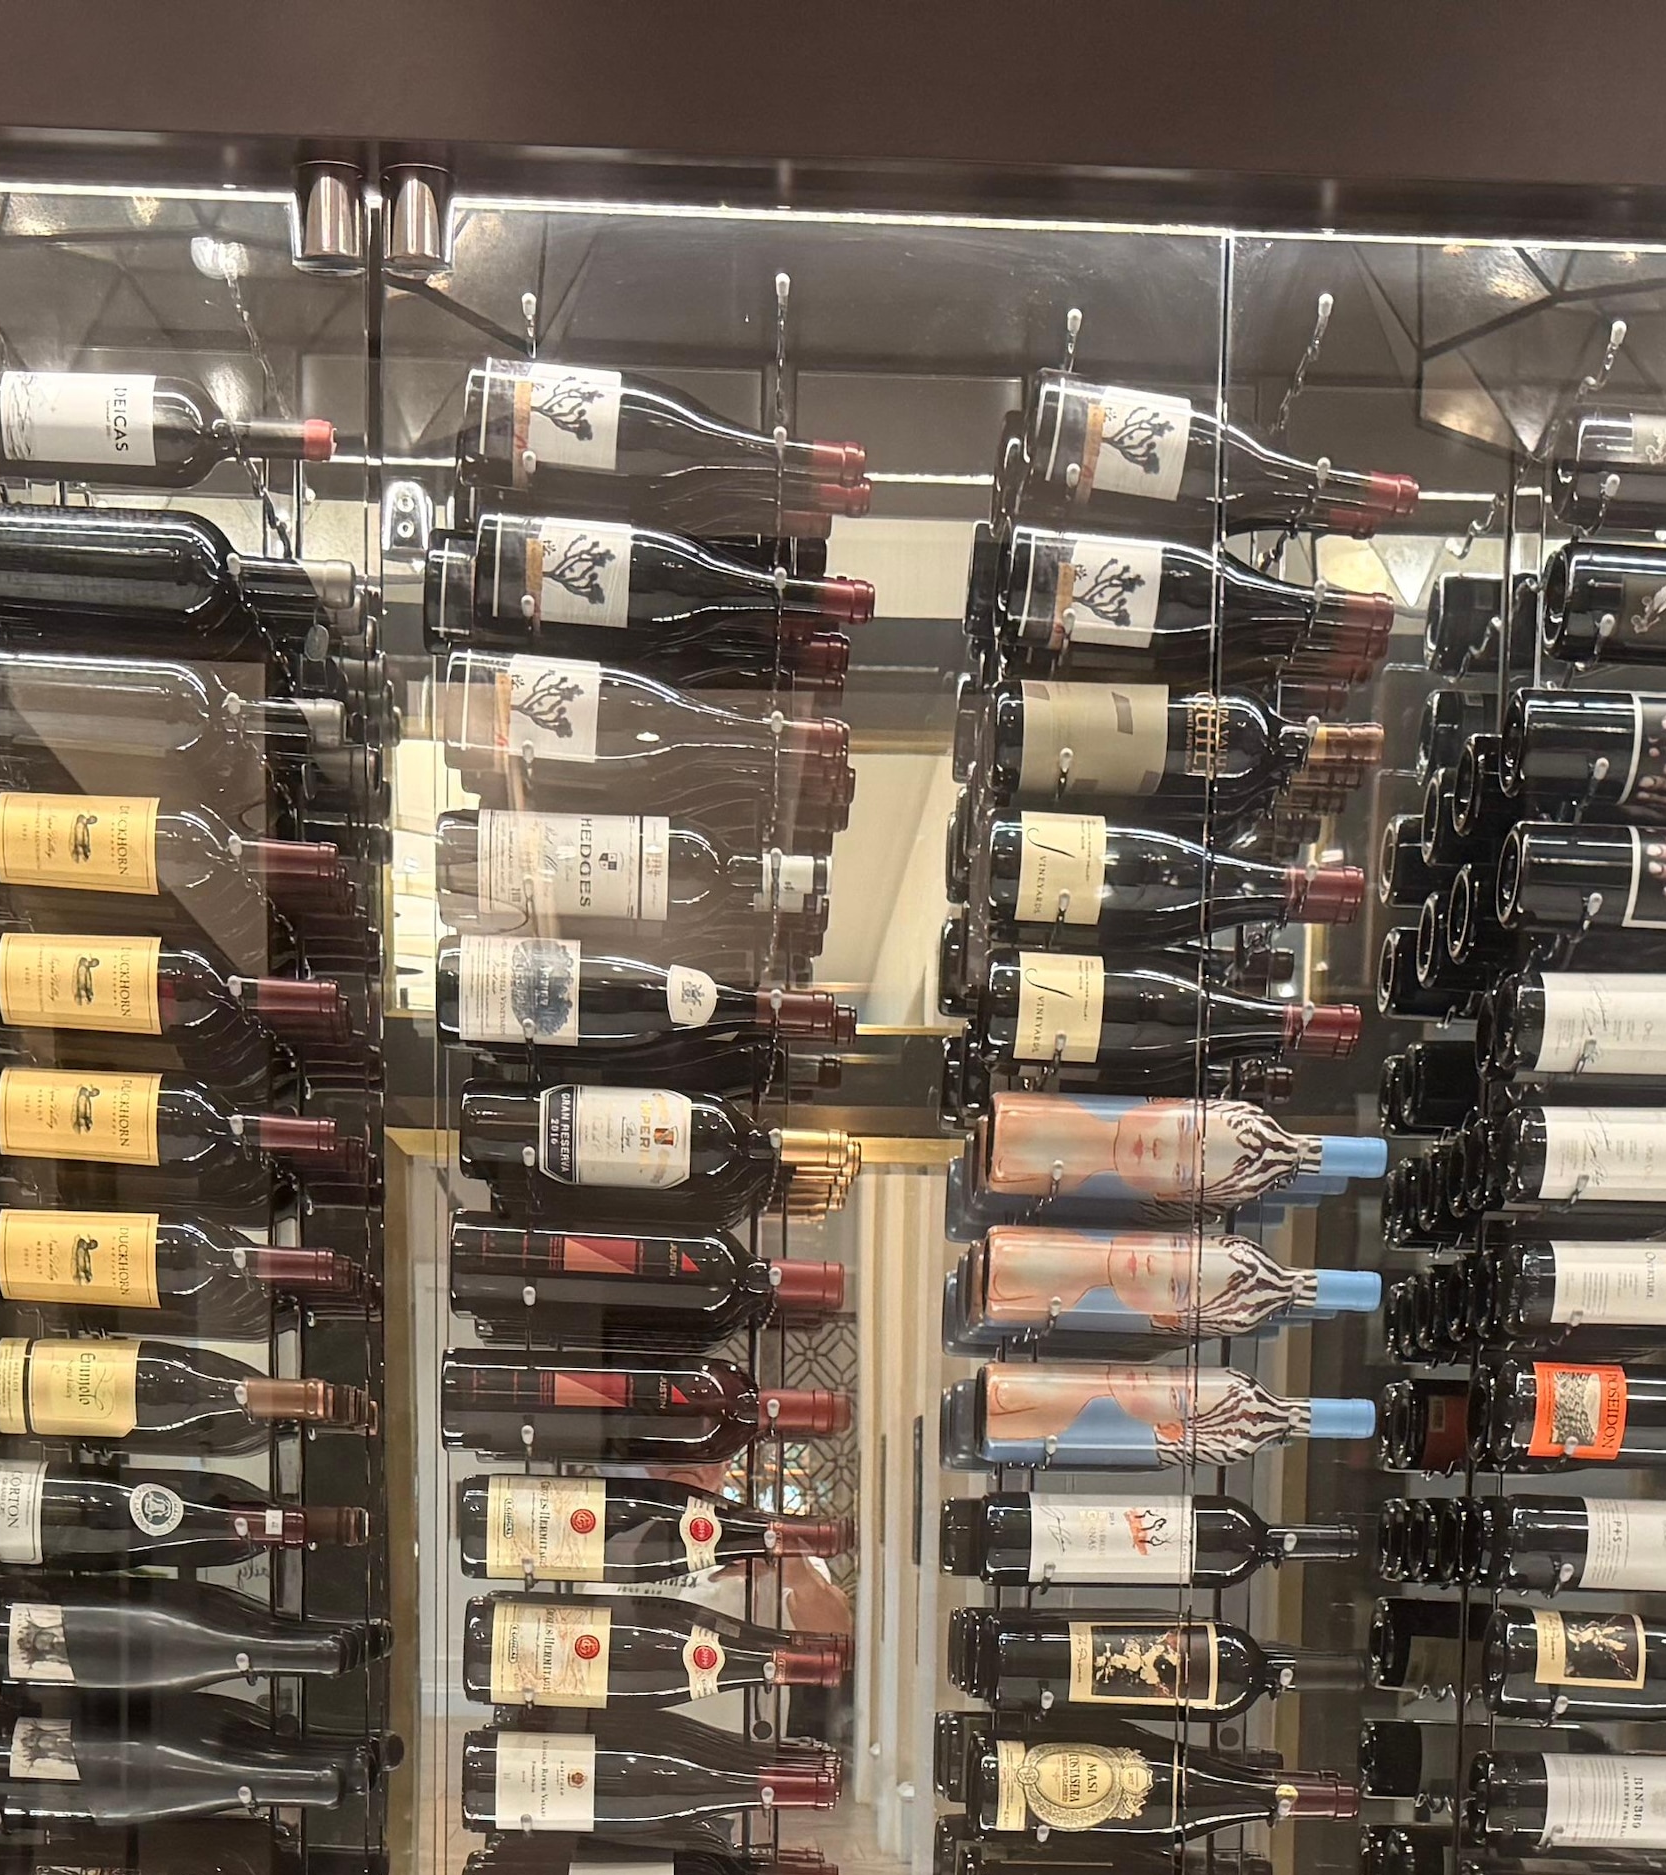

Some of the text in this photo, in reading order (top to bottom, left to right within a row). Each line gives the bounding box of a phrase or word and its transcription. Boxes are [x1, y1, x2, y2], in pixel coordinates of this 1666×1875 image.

[113, 387, 130, 452] DEICAS
[116, 804, 131, 877] DUCKHORN
[579, 818, 592, 908] HEDGES
[1032, 854, 1047, 914] VINEYARDS
[119, 946, 132, 1017] DUCKHORN
[1030, 995, 1045, 1054] VINEYARDS
[119, 1079, 132, 1147] DUCKHORN
[549, 1118, 561, 1144] 2016
[559, 1093, 571, 1172] GRAN RESERVA
[118, 1226, 131, 1296] DUCKHORN
[669, 1242, 677, 1276] JUSTIN
[1645, 1250, 1657, 1300] OVERTURE
[659, 1376, 668, 1409] JUSTIN
[1601, 1372, 1621, 1450] POSEIDON
[7, 1470, 23, 1529] CORTON
[1085, 1762, 1099, 1794] MASI
[1621, 1766, 1631, 1808] CABERNET
[1633, 1776, 1645, 1802] BIN
